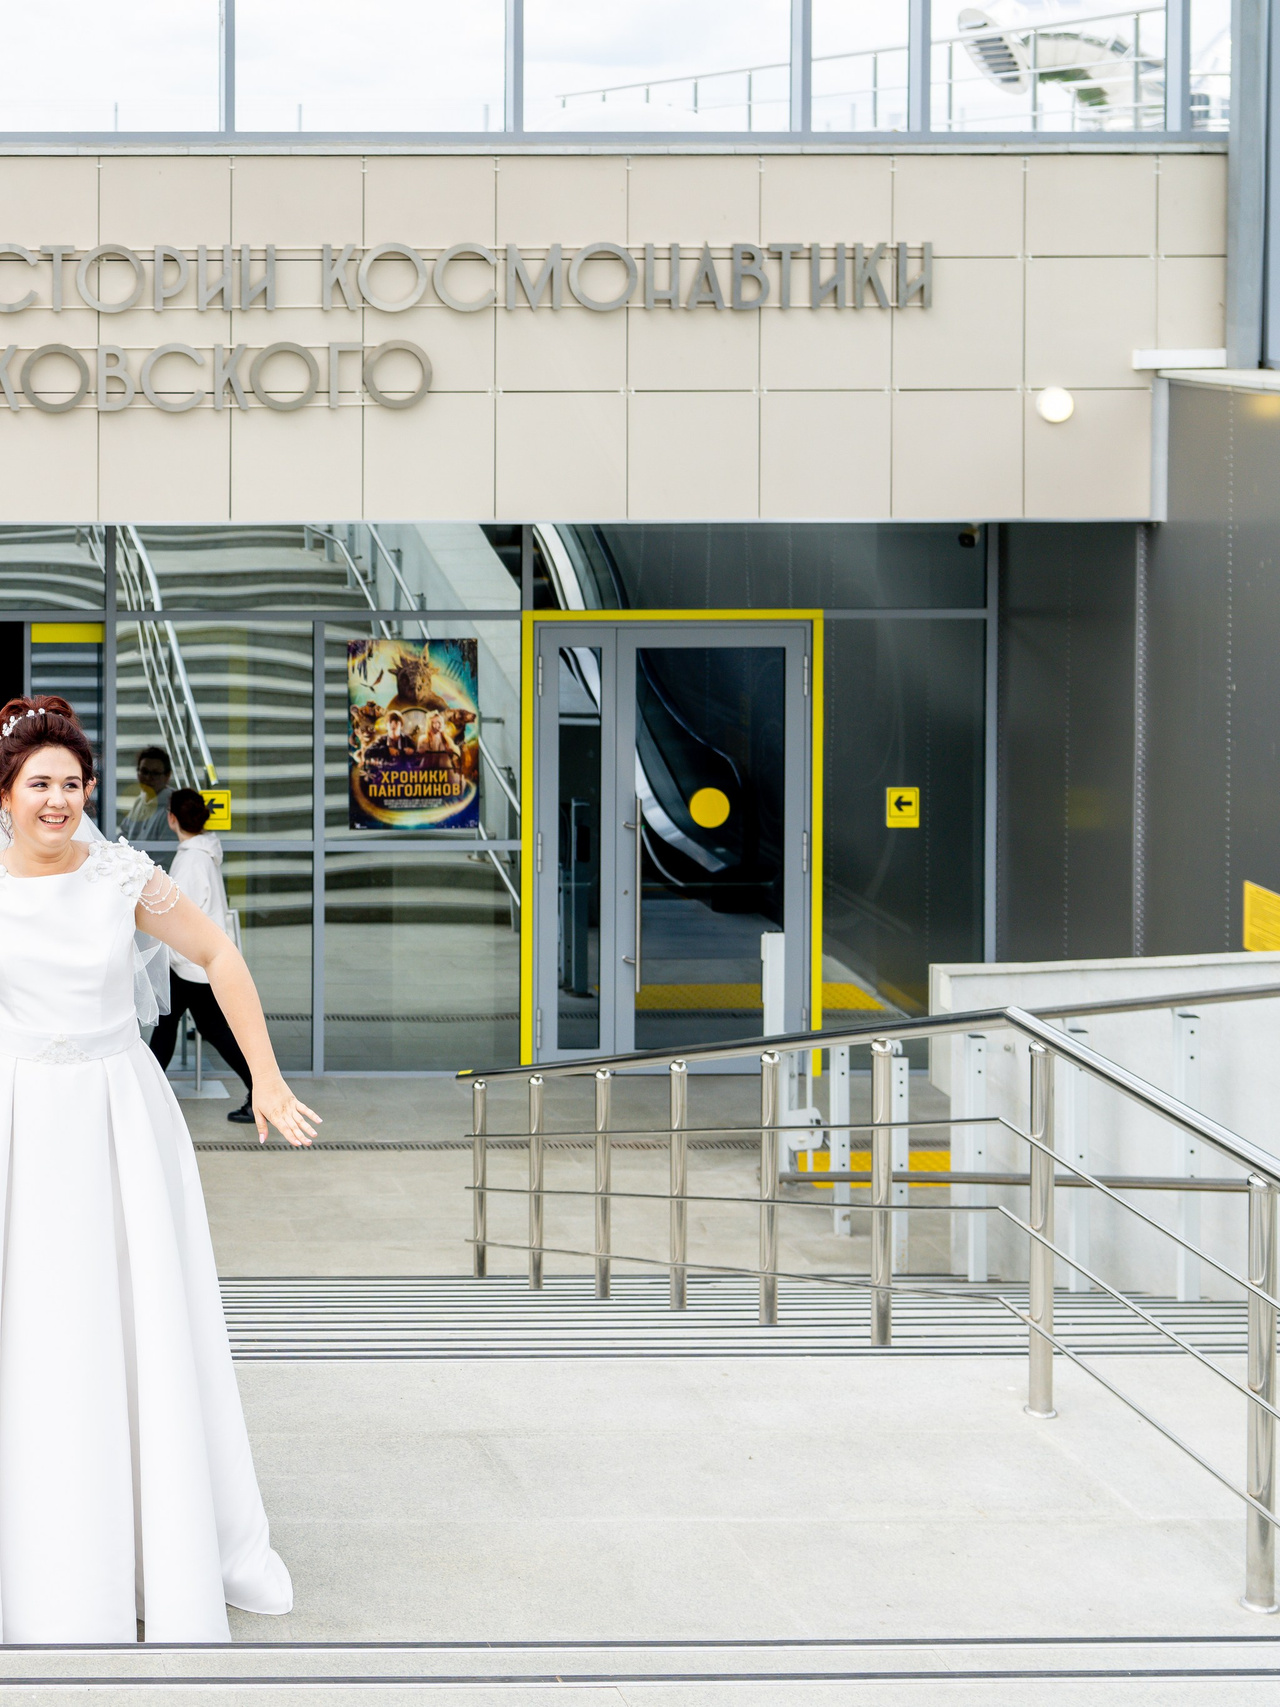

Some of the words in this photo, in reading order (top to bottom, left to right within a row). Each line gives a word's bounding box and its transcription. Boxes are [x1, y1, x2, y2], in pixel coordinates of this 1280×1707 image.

[322, 240, 933, 312] КОСМОНАВТИКИ
[380, 769, 449, 784] ХРОНИКИ
[368, 783, 461, 797] ПАНГОЛИНОВ
